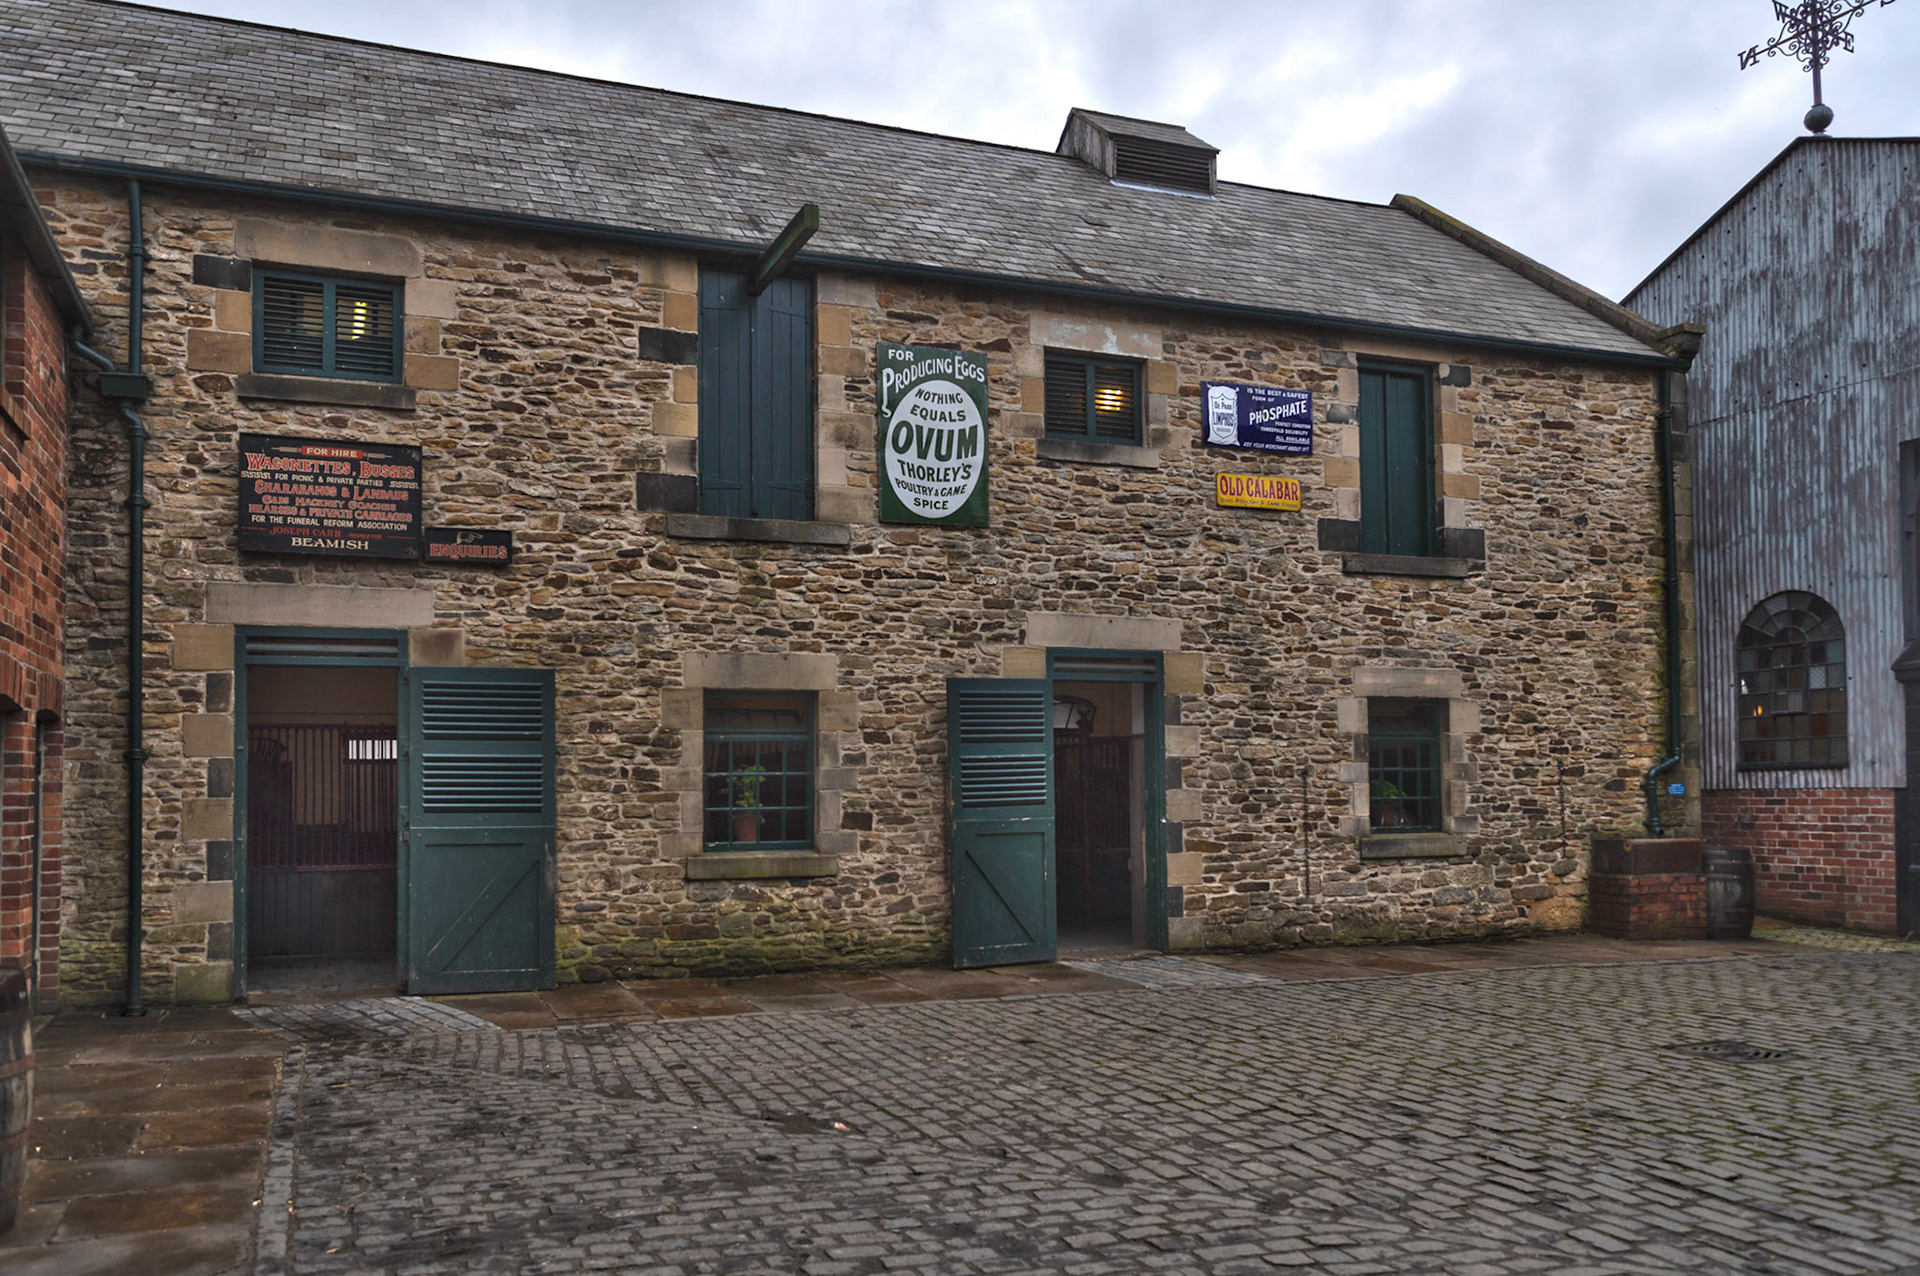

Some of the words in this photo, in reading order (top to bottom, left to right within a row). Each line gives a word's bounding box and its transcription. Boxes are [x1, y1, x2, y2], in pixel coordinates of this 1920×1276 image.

[888, 349, 914, 361] FOR
[881, 358, 953, 418] PRODUCING
[954, 356, 985, 383] EGGS
[1254, 388, 1266, 396] THE
[1267, 389, 1282, 397] BEST
[1286, 391, 1309, 400] SAFEST
[914, 388, 964, 405] NOTHING
[910, 404, 967, 422] EQUALS
[1249, 400, 1307, 425] PHOSPHATE
[891, 420, 978, 462] OVUM
[307, 447, 328, 455] FOR
[332, 449, 357, 458] HIRE
[360, 462, 415, 479] BUSSES
[897, 459, 972, 482] THORLEY'S
[292, 474, 314, 482] PICNIC
[357, 478, 383, 486] PARTIES
[894, 477, 934, 497] POULTRY
[934, 489, 940, 497] &
[940, 484, 968, 497] GAME
[1219, 475, 1244, 496] OLD
[1245, 477, 1299, 501] CALABAR
[341, 486, 350, 498] &
[354, 486, 409, 501] LANDAUS
[262, 494, 289, 504] CABS
[295, 496, 345, 508] HACKNEY
[348, 500, 397, 511] COACHES
[913, 498, 949, 510] SPICE
[249, 503, 298, 515] HEARSES
[299, 507, 307, 517] &
[309, 507, 353, 519] PRIVATE
[355, 510, 412, 522] CARRIAGES
[252, 514, 266, 522] FOR
[269, 515, 284, 523] THE
[287, 516, 320, 526] FUNERAL
[324, 518, 354, 527] REFORM
[358, 521, 407, 531] ASSOCIATION
[268, 526, 309, 536] JOSEPH
[312, 528, 341, 538] CARR
[292, 537, 369, 550] BEAMISH
[430, 543, 507, 559] ENQUIRIES
